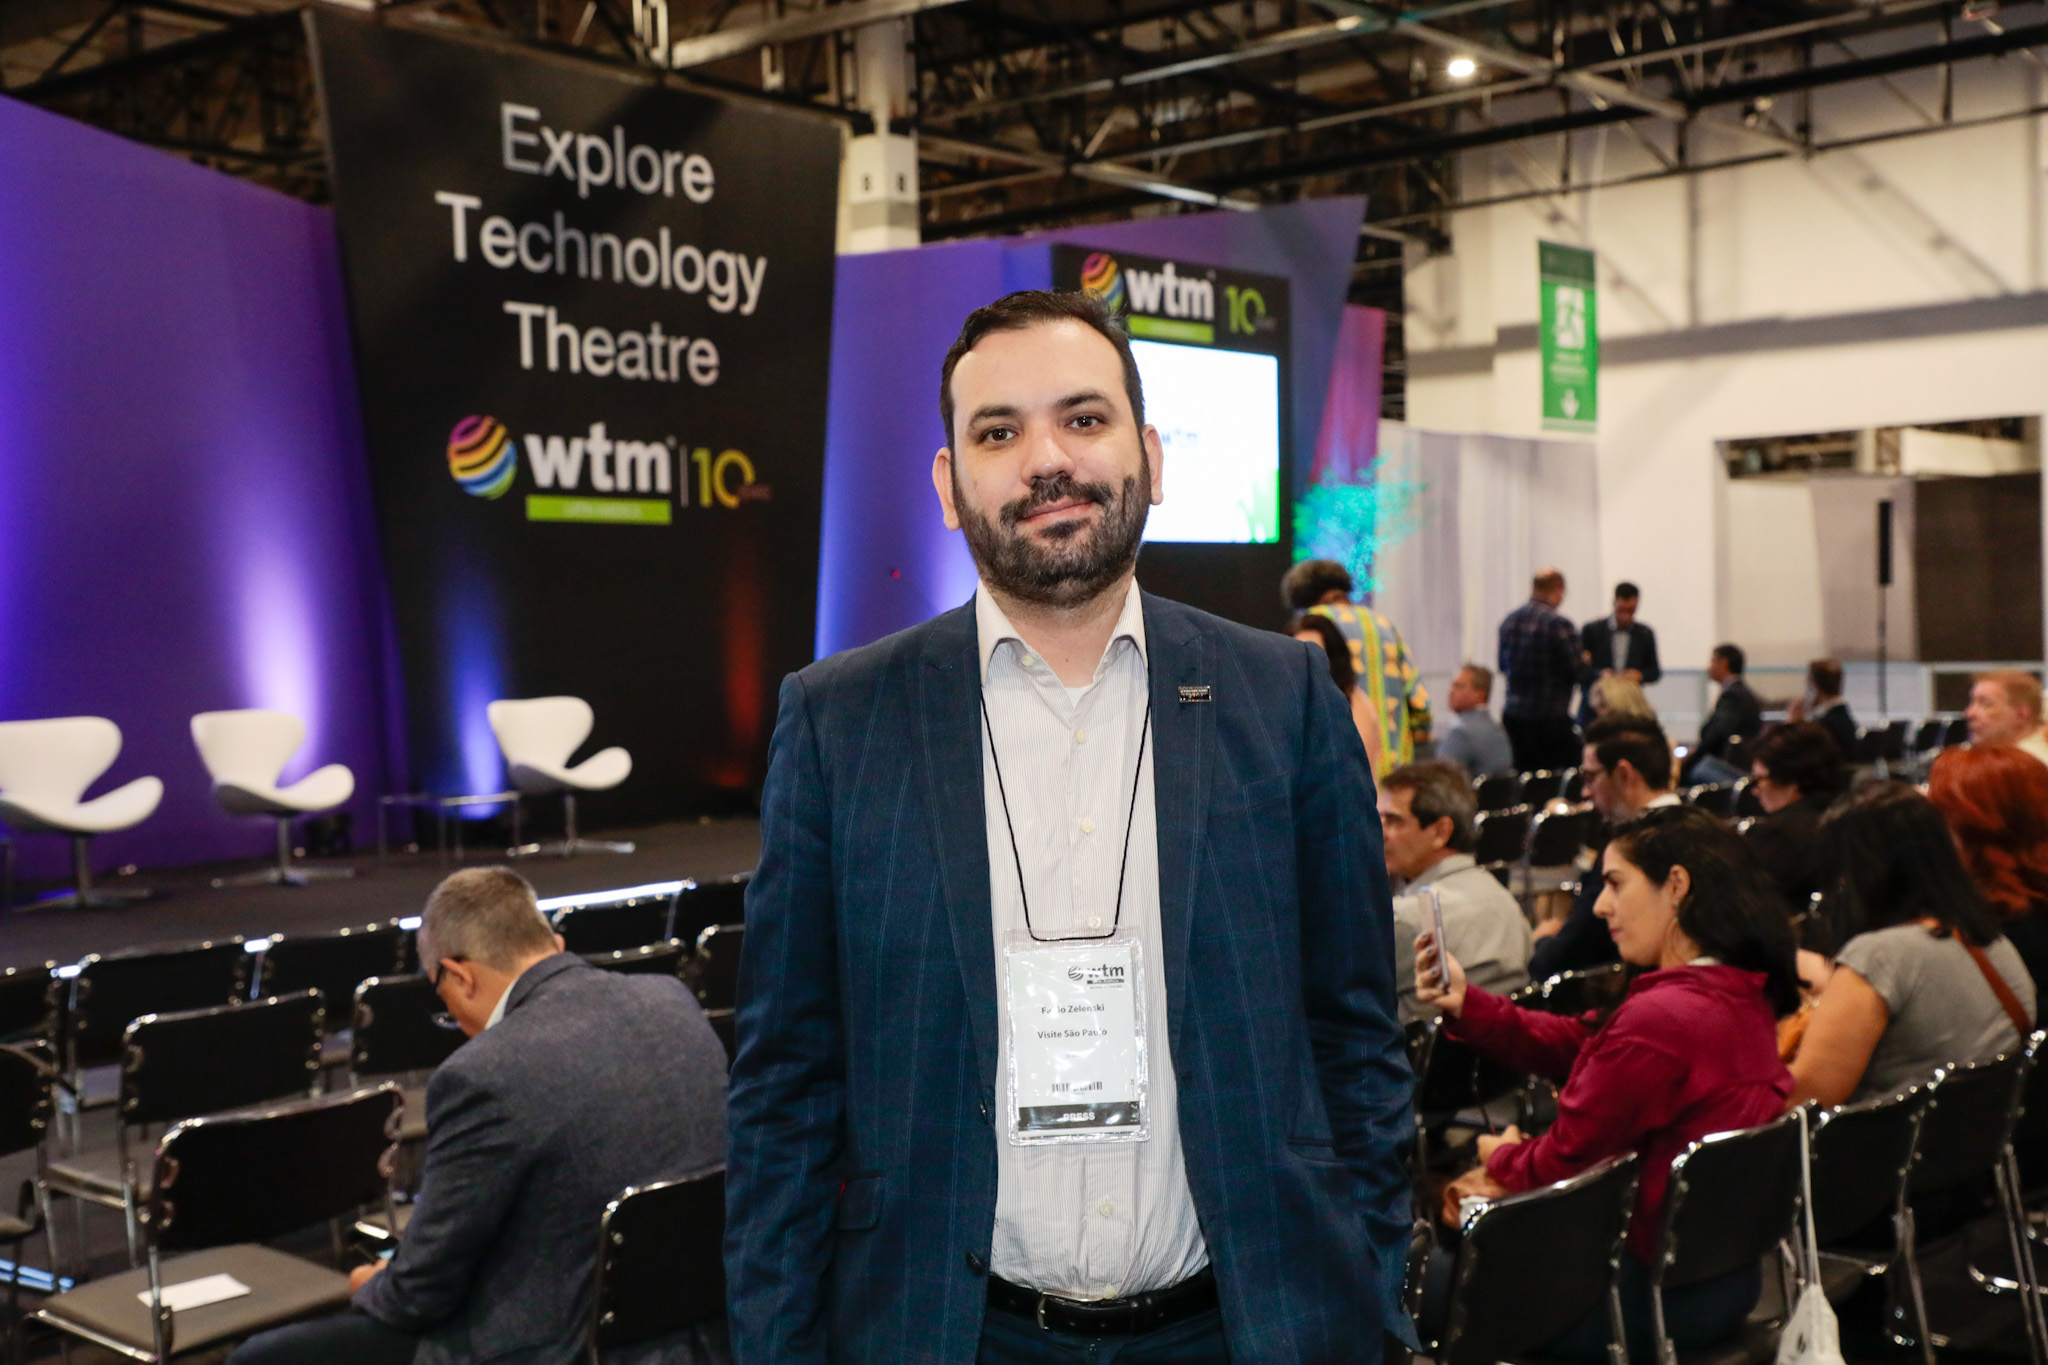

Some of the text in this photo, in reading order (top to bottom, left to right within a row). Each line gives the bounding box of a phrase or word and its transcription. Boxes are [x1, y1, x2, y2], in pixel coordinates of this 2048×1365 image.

[501, 101, 715, 203] Explore
[434, 190, 768, 316] Technology
[1124, 261, 1267, 335] wtm 10
[502, 300, 721, 386] Theatre
[523, 421, 757, 509] wtm 10
[1037, 1030, 1063, 1040] Visite
[1063, 1028, 1081, 1038] São
[1062, 1111, 1096, 1122] PRESS
